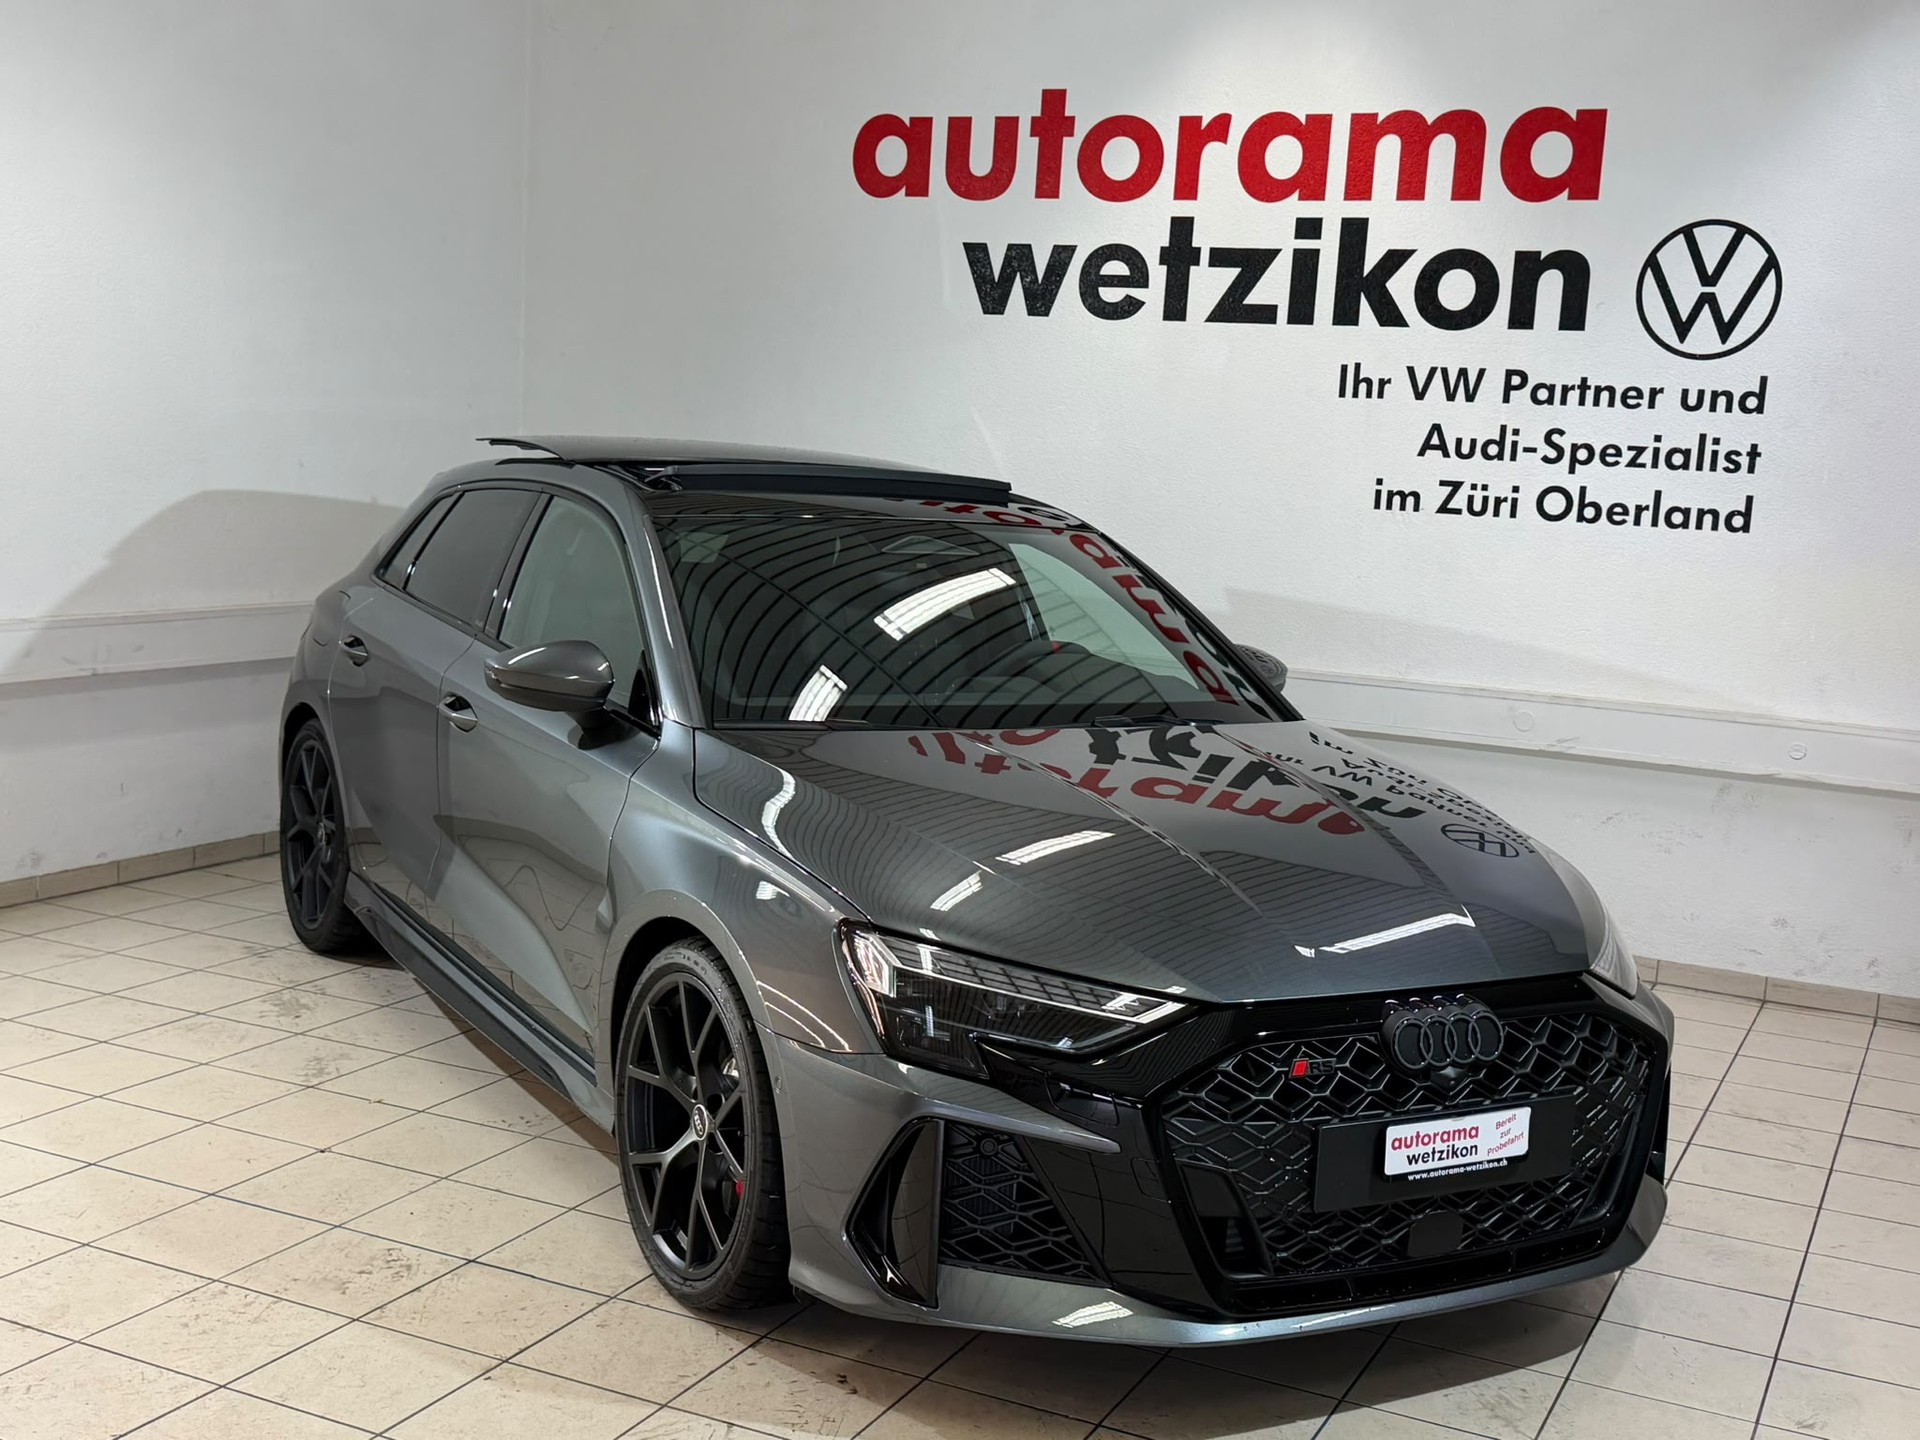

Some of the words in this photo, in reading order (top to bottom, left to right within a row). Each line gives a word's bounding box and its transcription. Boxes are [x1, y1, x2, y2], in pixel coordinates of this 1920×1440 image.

[854, 89, 1608, 203] autorama
[963, 216, 1591, 332] wetzikon
[1338, 363, 1392, 400] Ihr
[1406, 365, 1487, 403] VW
[1502, 368, 1665, 411] Partner
[1680, 376, 1768, 415] und
[1416, 423, 1762, 475] Audi-Spezialist
[1373, 478, 1421, 513] im
[1435, 479, 1520, 519] Züri
[1535, 485, 1754, 534] Oberland
[1495, 1113, 1517, 1130] Bereit
[1499, 1128, 1512, 1139] zur
[1391, 1125, 1480, 1151] autorama
[1487, 1131, 1525, 1157] Probefahrt
[1406, 1144, 1478, 1166] wetzikon
[1407, 1159, 1508, 1181] www.autorama-wetzikon.ch
